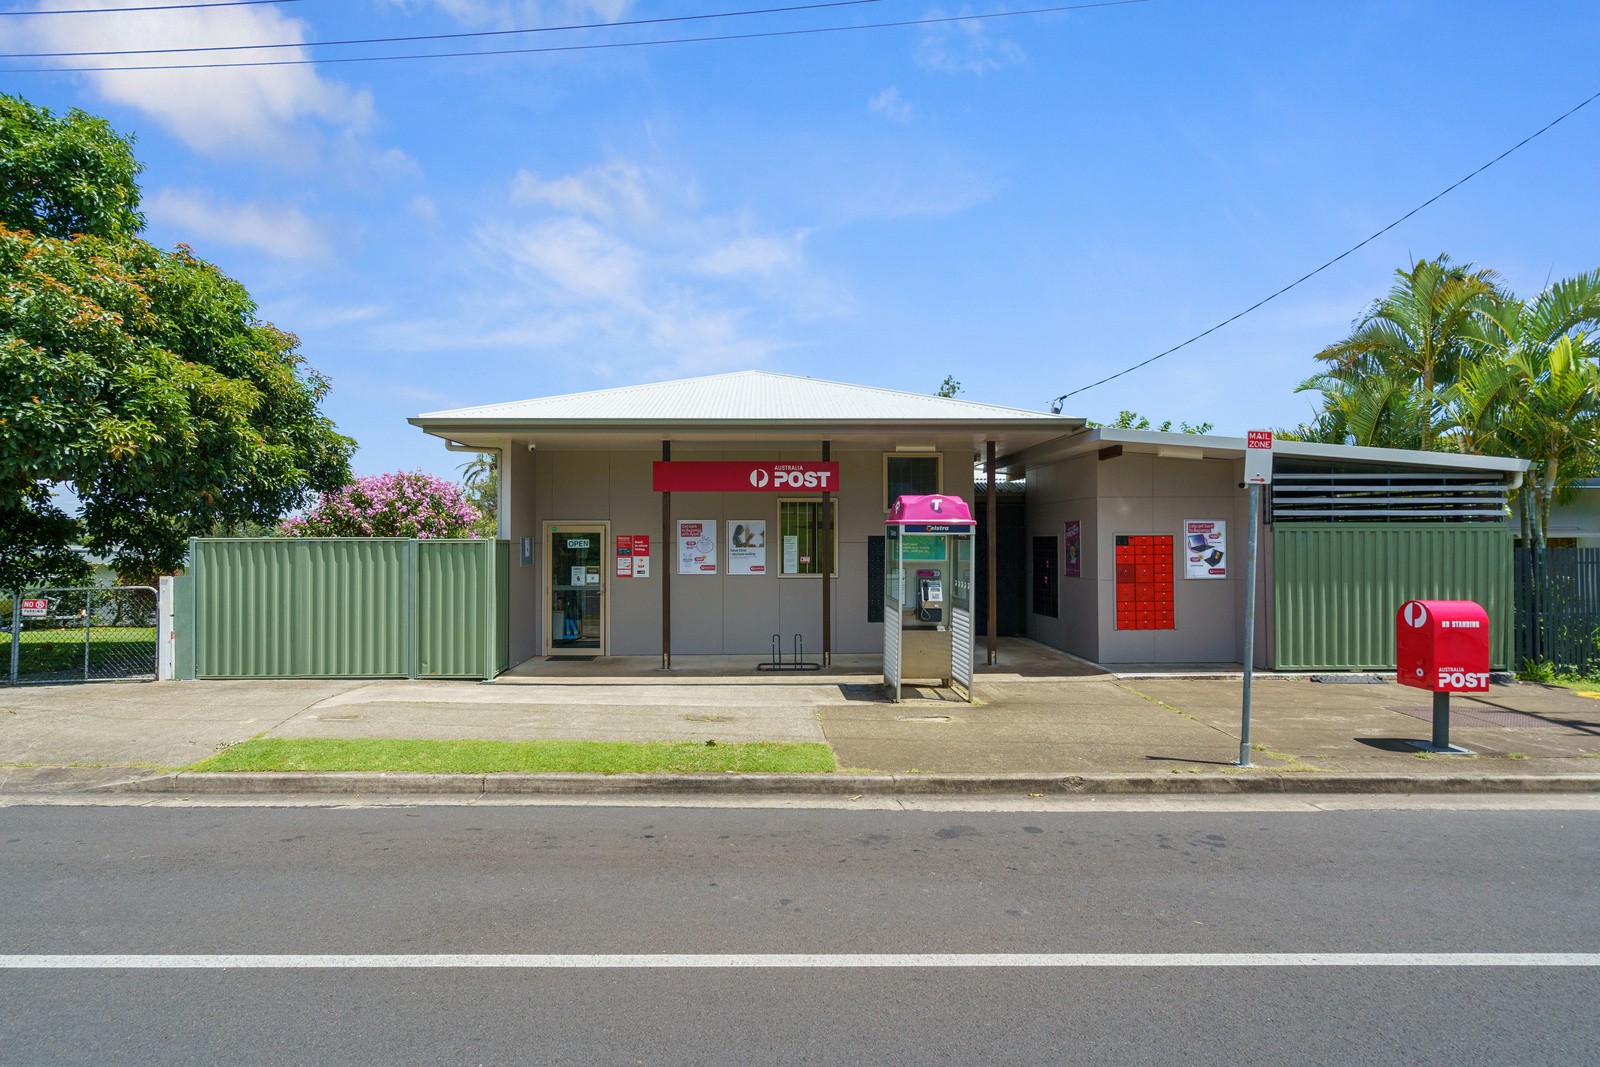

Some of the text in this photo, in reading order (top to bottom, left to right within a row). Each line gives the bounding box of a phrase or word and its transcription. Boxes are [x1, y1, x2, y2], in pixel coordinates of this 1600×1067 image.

[1249, 432, 1270, 440] MAIL
[1249, 440, 1270, 448] ZONE
[774, 471, 830, 488] POST
[568, 540, 589, 548] OPEN
[1438, 672, 1489, 688] POST
